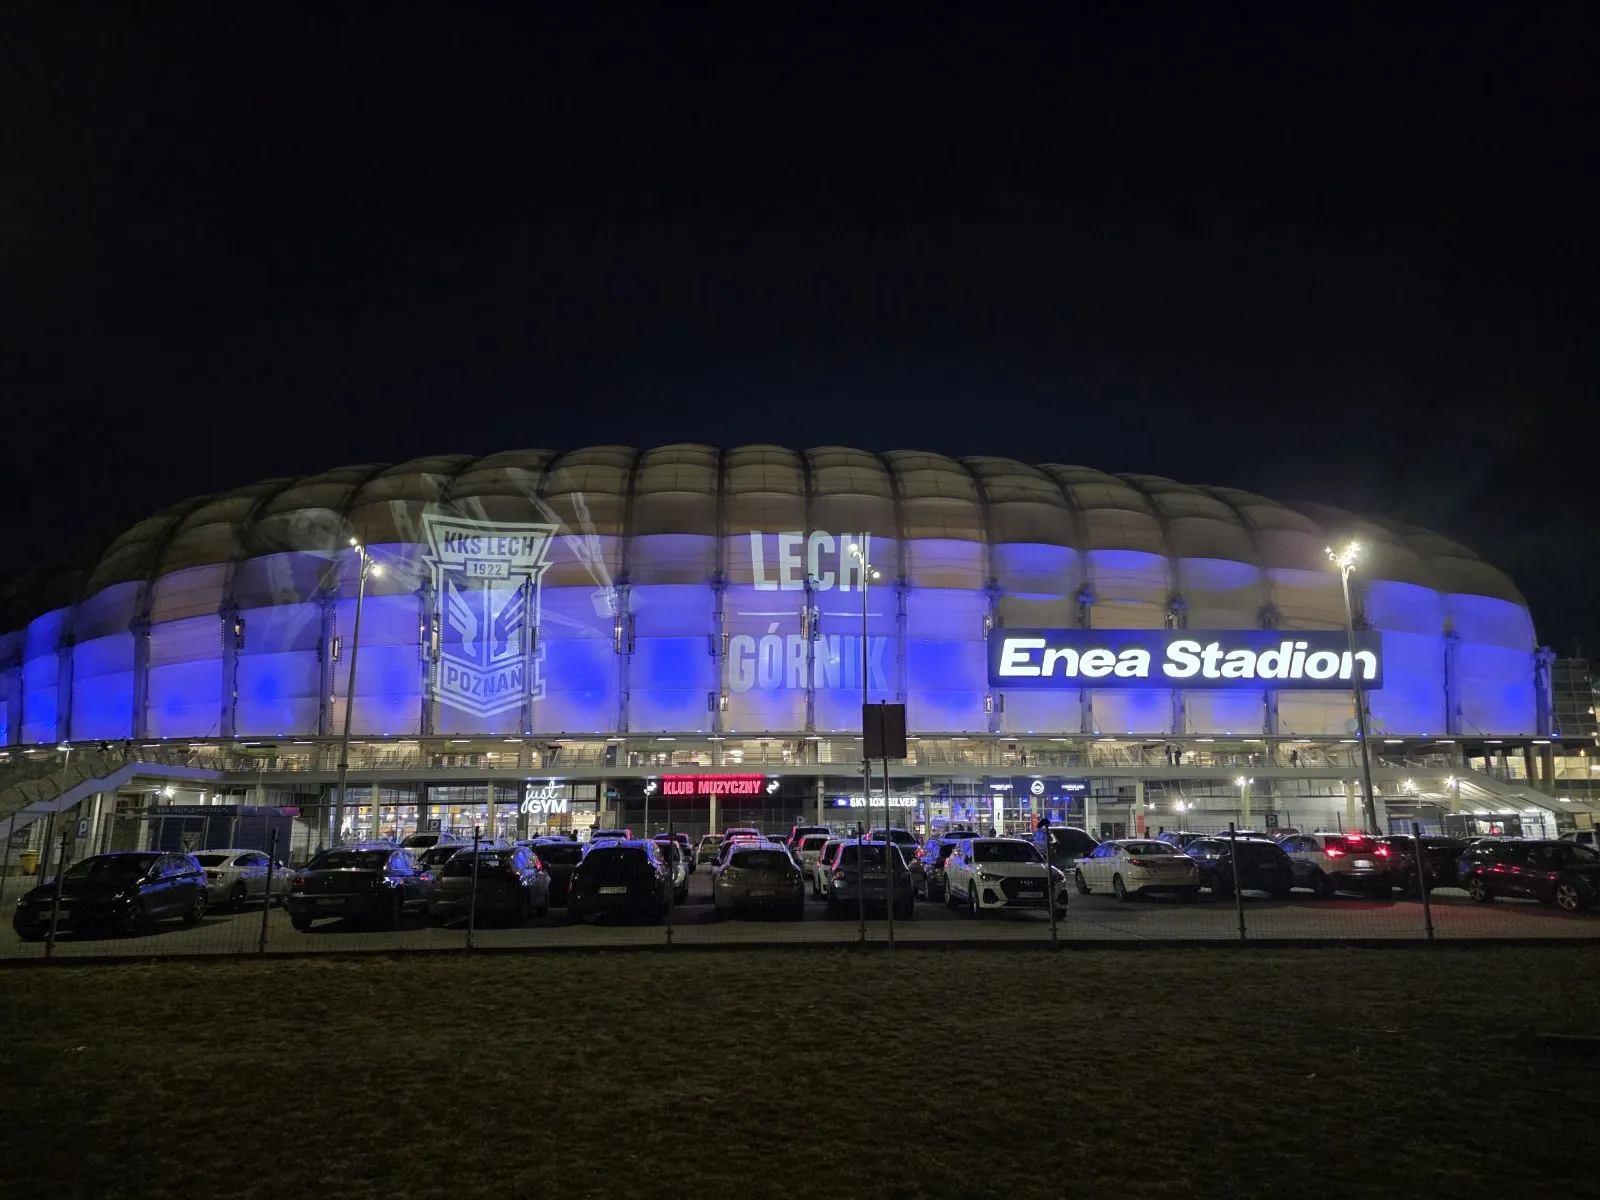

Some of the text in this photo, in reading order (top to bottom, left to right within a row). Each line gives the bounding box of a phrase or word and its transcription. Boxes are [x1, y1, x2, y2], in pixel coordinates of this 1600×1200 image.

[445, 531, 535, 557] KKS LECH
[473, 563, 502, 576] 1922
[750, 531, 870, 592] LECH
[728, 622, 889, 693] GÓRNIK
[999, 638, 1377, 679] Enea Stadion
[447, 665, 523, 698] POZNAŃ
[521, 776, 565, 813] just
[663, 780, 761, 795] KLUB MUZYCZNY
[528, 799, 567, 813] GYM
[1268, 815, 1276, 825] P
